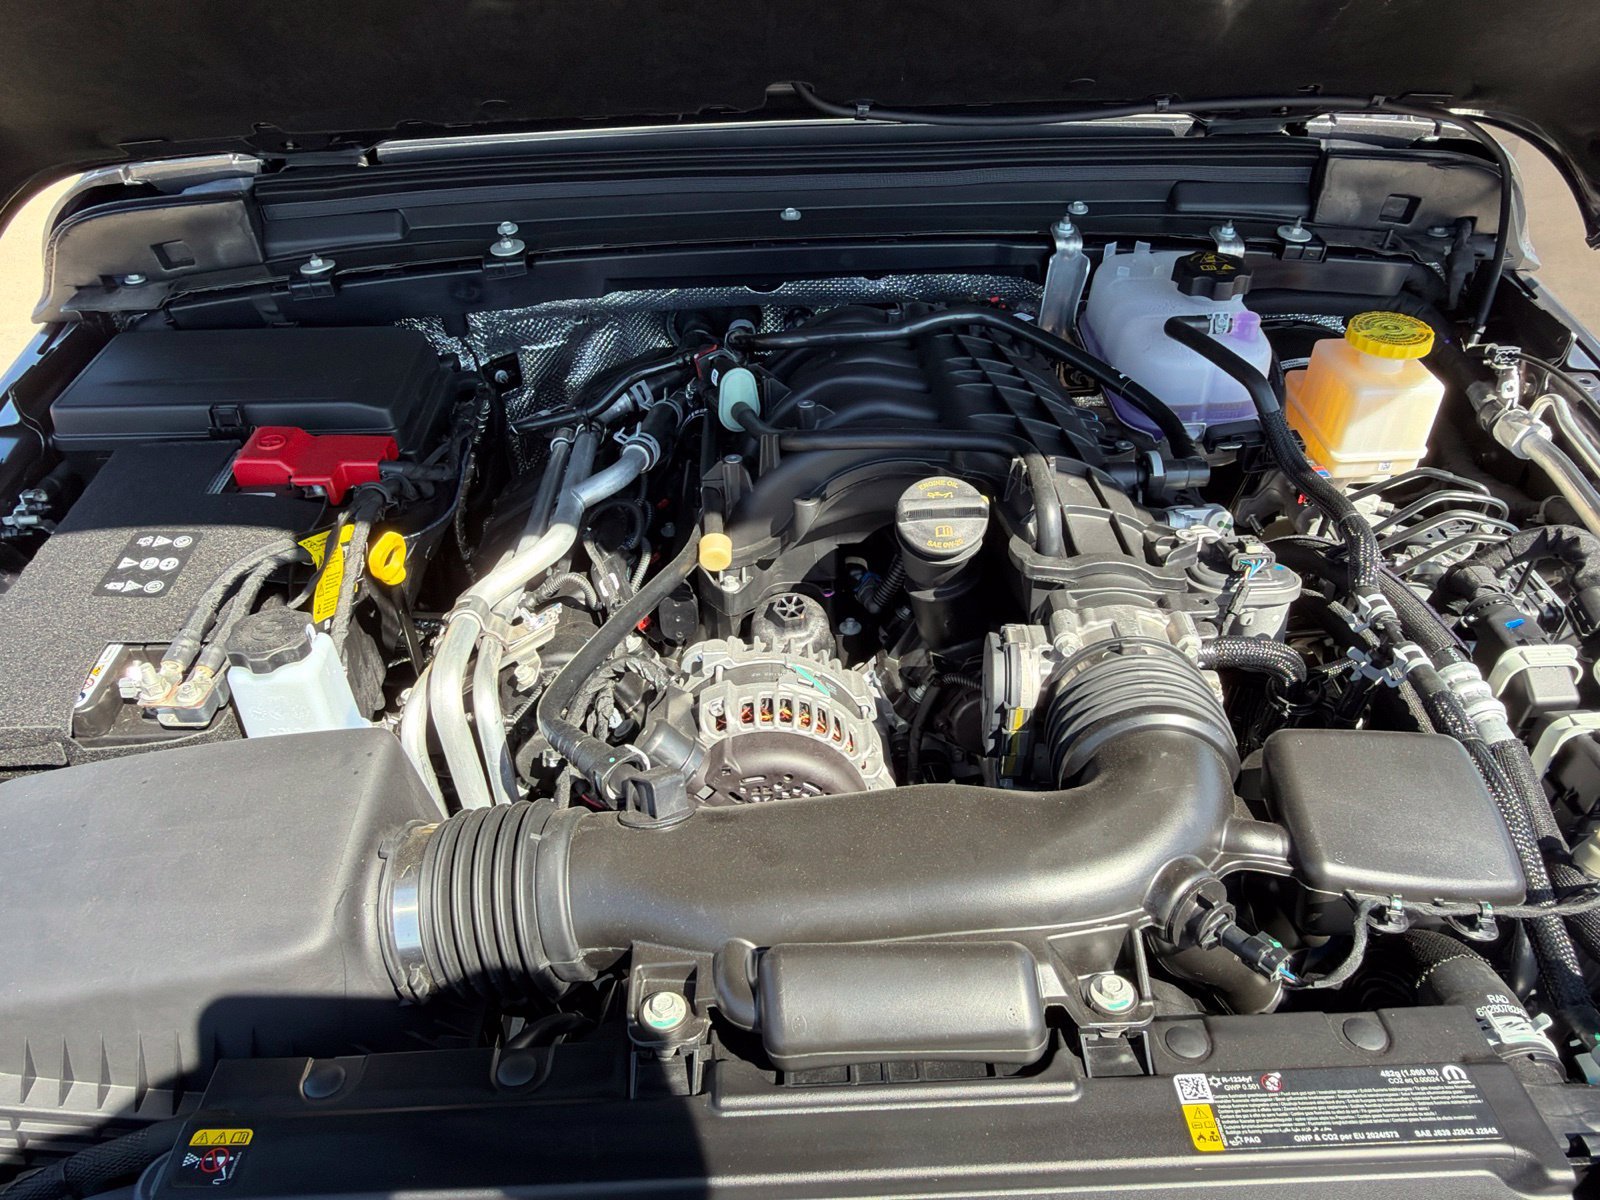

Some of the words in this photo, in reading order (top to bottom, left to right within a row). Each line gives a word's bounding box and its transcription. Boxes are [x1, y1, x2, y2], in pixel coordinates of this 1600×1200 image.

[918, 480, 946, 490] ENGINE
[946, 480, 958, 489] OIL
[927, 540, 942, 548] SAE
[942, 538, 964, 548] 0W-20
[1486, 994, 1510, 1004] RAD
[1244, 1136, 1262, 1144] PAG
[1294, 1134, 1312, 1142] GWP
[1340, 1133, 1352, 1141] per
[1352, 1132, 1366, 1140] EU
[1414, 1129, 1432, 1137] SAE
